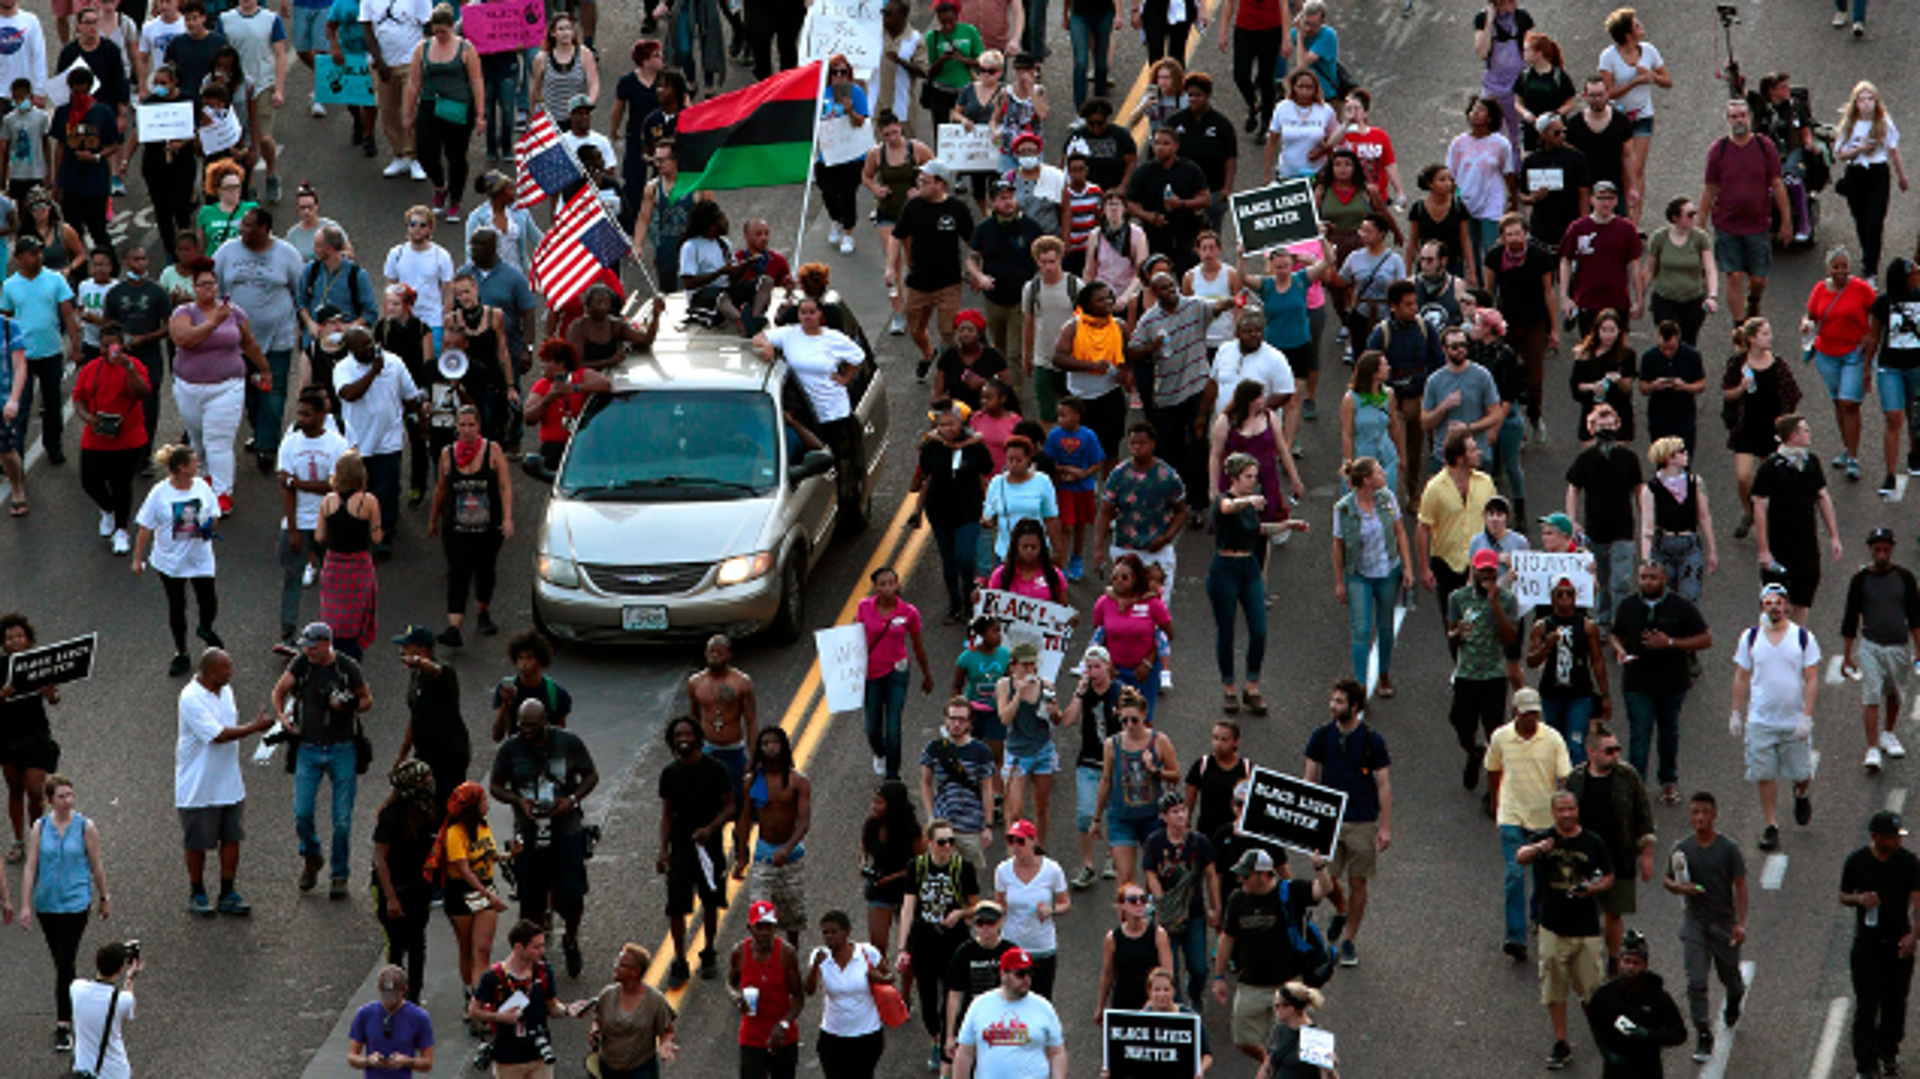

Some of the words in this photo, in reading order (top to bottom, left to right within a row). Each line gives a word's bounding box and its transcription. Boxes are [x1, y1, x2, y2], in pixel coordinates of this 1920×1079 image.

[1239, 200, 1273, 218] BLACK
[1275, 192, 1307, 210] LIVES
[1253, 211, 1300, 231] MATTER
[15, 656, 53, 673] BLACK
[56, 646, 89, 662] LIVES
[27, 661, 75, 680] MATTER
[1255, 782, 1295, 805] BLACK
[1297, 795, 1338, 818] LIVES
[1264, 803, 1320, 830] MATTER
[1110, 1026, 1150, 1041] BLACK
[1153, 1027, 1193, 1044] LIVES
[1124, 1045, 1179, 1063] MATTER
